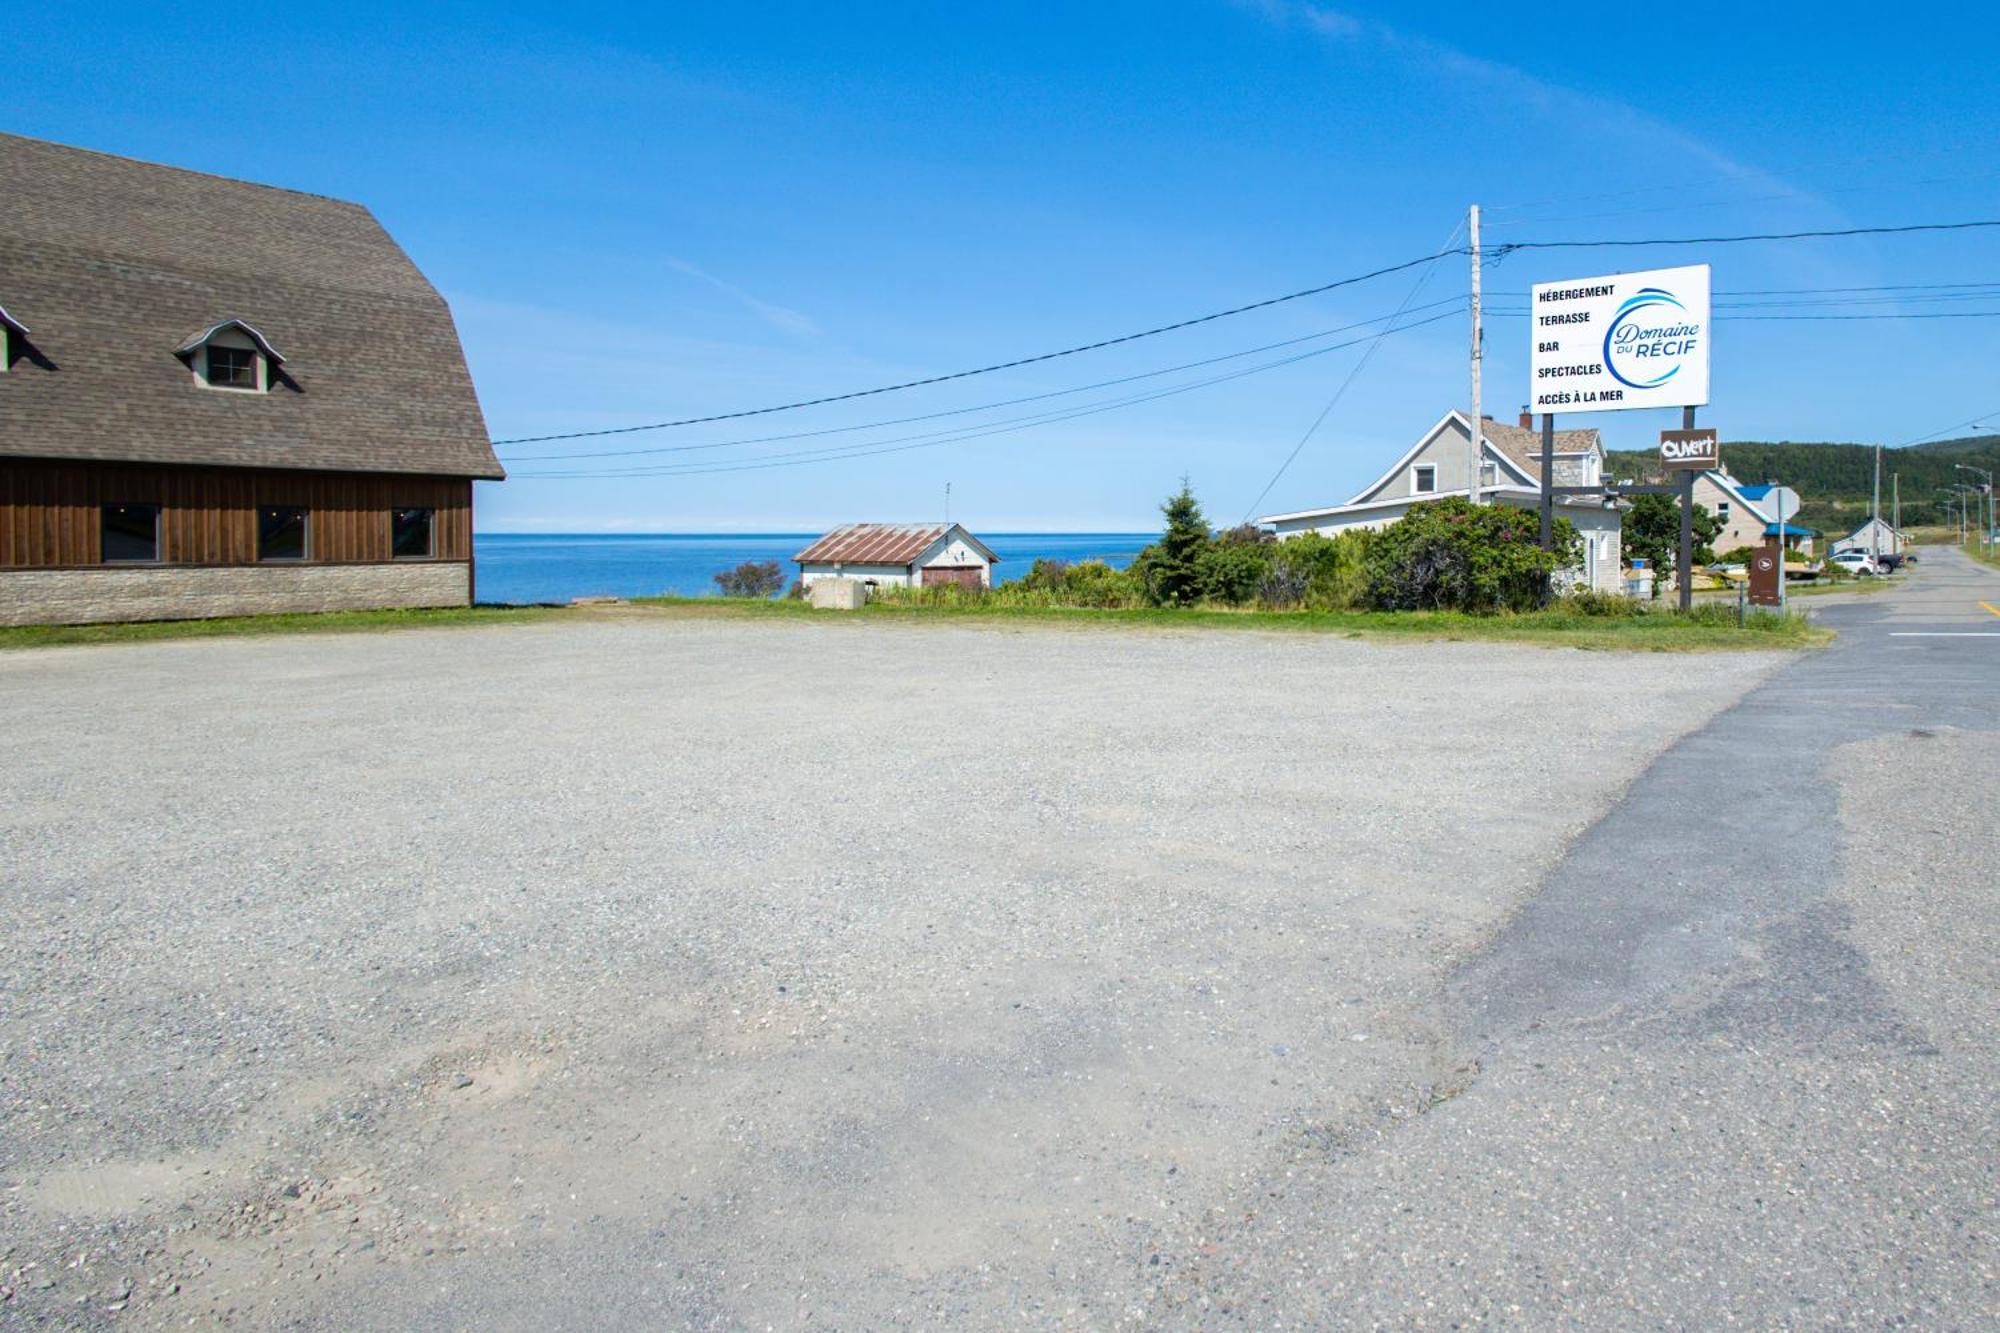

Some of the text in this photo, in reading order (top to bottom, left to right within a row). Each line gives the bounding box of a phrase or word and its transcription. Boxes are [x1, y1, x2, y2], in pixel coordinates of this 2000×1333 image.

[1539, 285, 1615, 302] HÉBERGEMENT
[1539, 312, 1590, 326] TERRASSE
[1614, 322, 1699, 344] Domaine
[1538, 341, 1559, 353] BAR
[1616, 340, 1697, 358] DU RÉCIF
[1538, 364, 1602, 378] SPECTACLES
[1538, 390, 1623, 405] ACCÈS À LA MER
